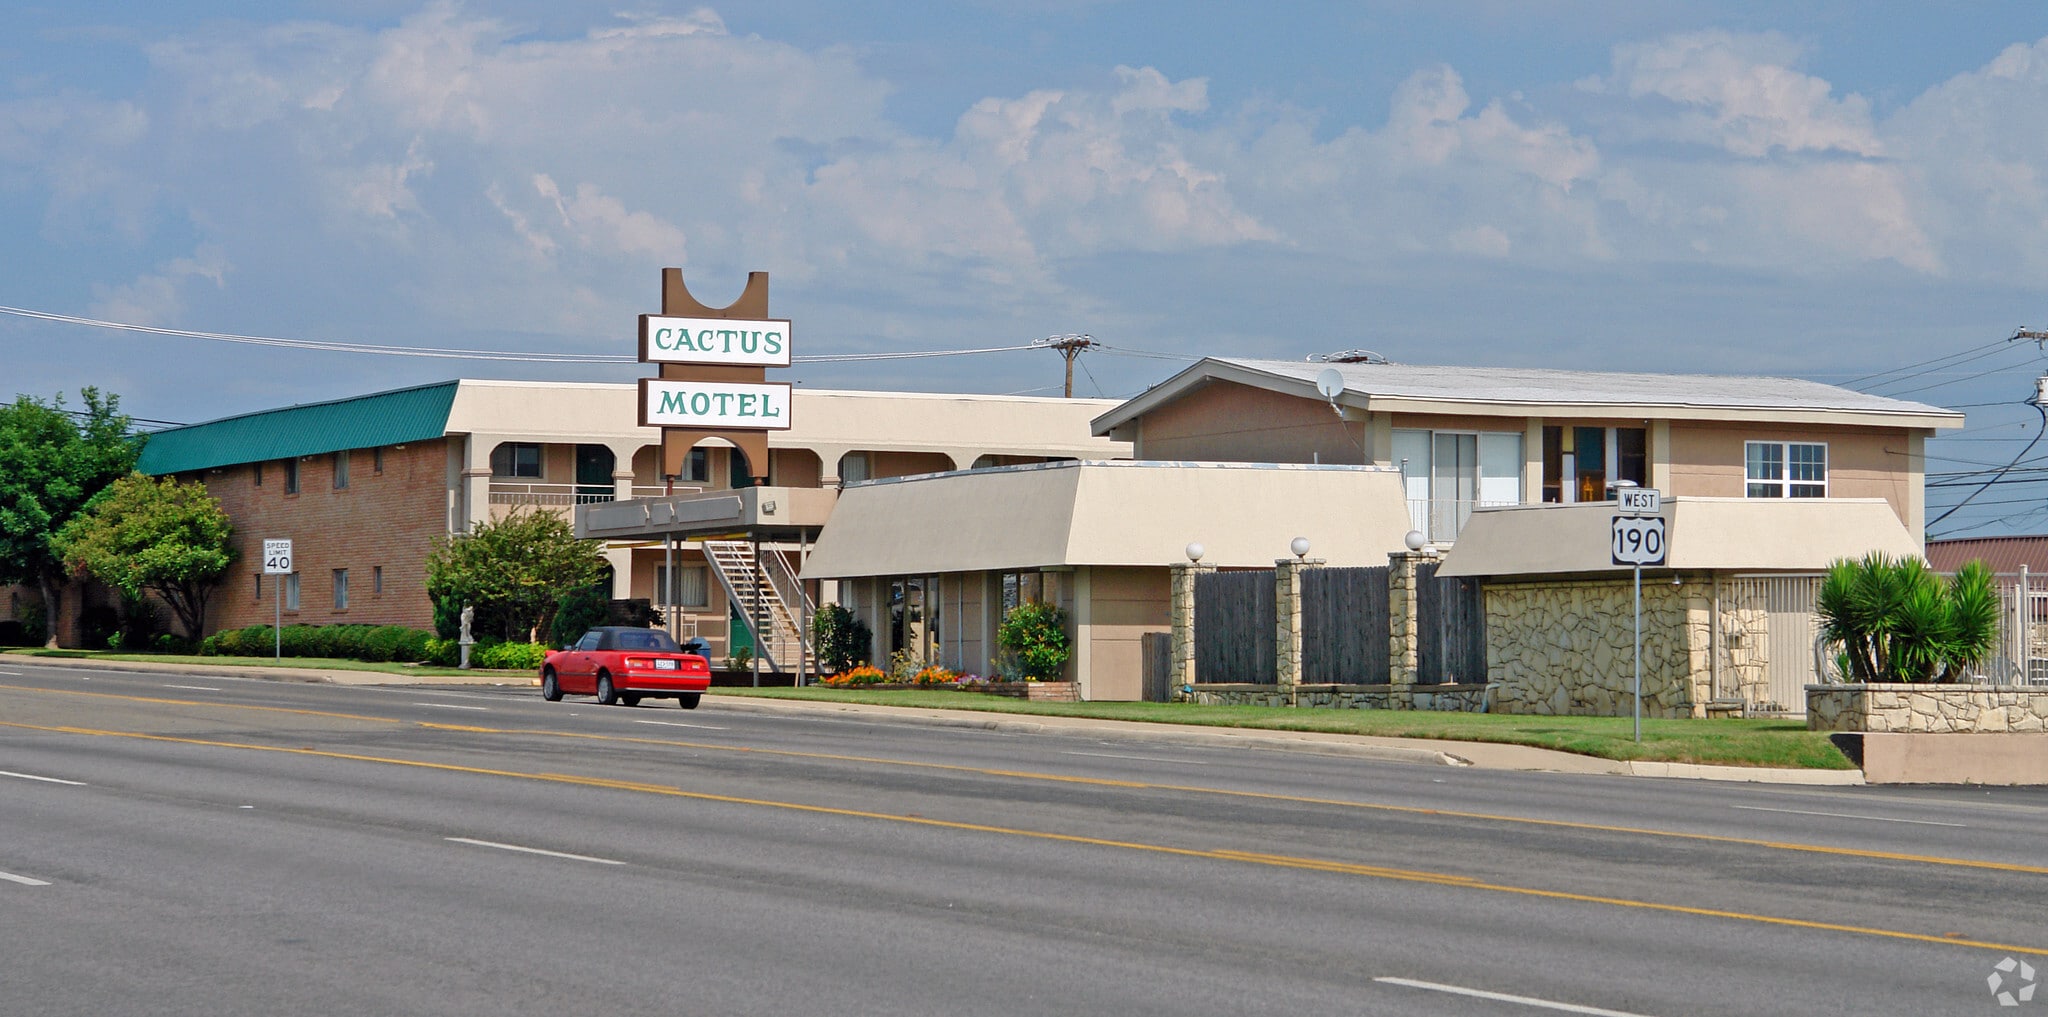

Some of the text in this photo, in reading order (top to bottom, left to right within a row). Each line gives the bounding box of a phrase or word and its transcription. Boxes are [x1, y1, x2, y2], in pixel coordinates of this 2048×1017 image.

[655, 328, 782, 355] CACTUS
[656, 390, 780, 417] MOTEL
[1624, 493, 1655, 508] WEST
[1617, 528, 1660, 555] 190
[266, 556, 290, 569] 40
